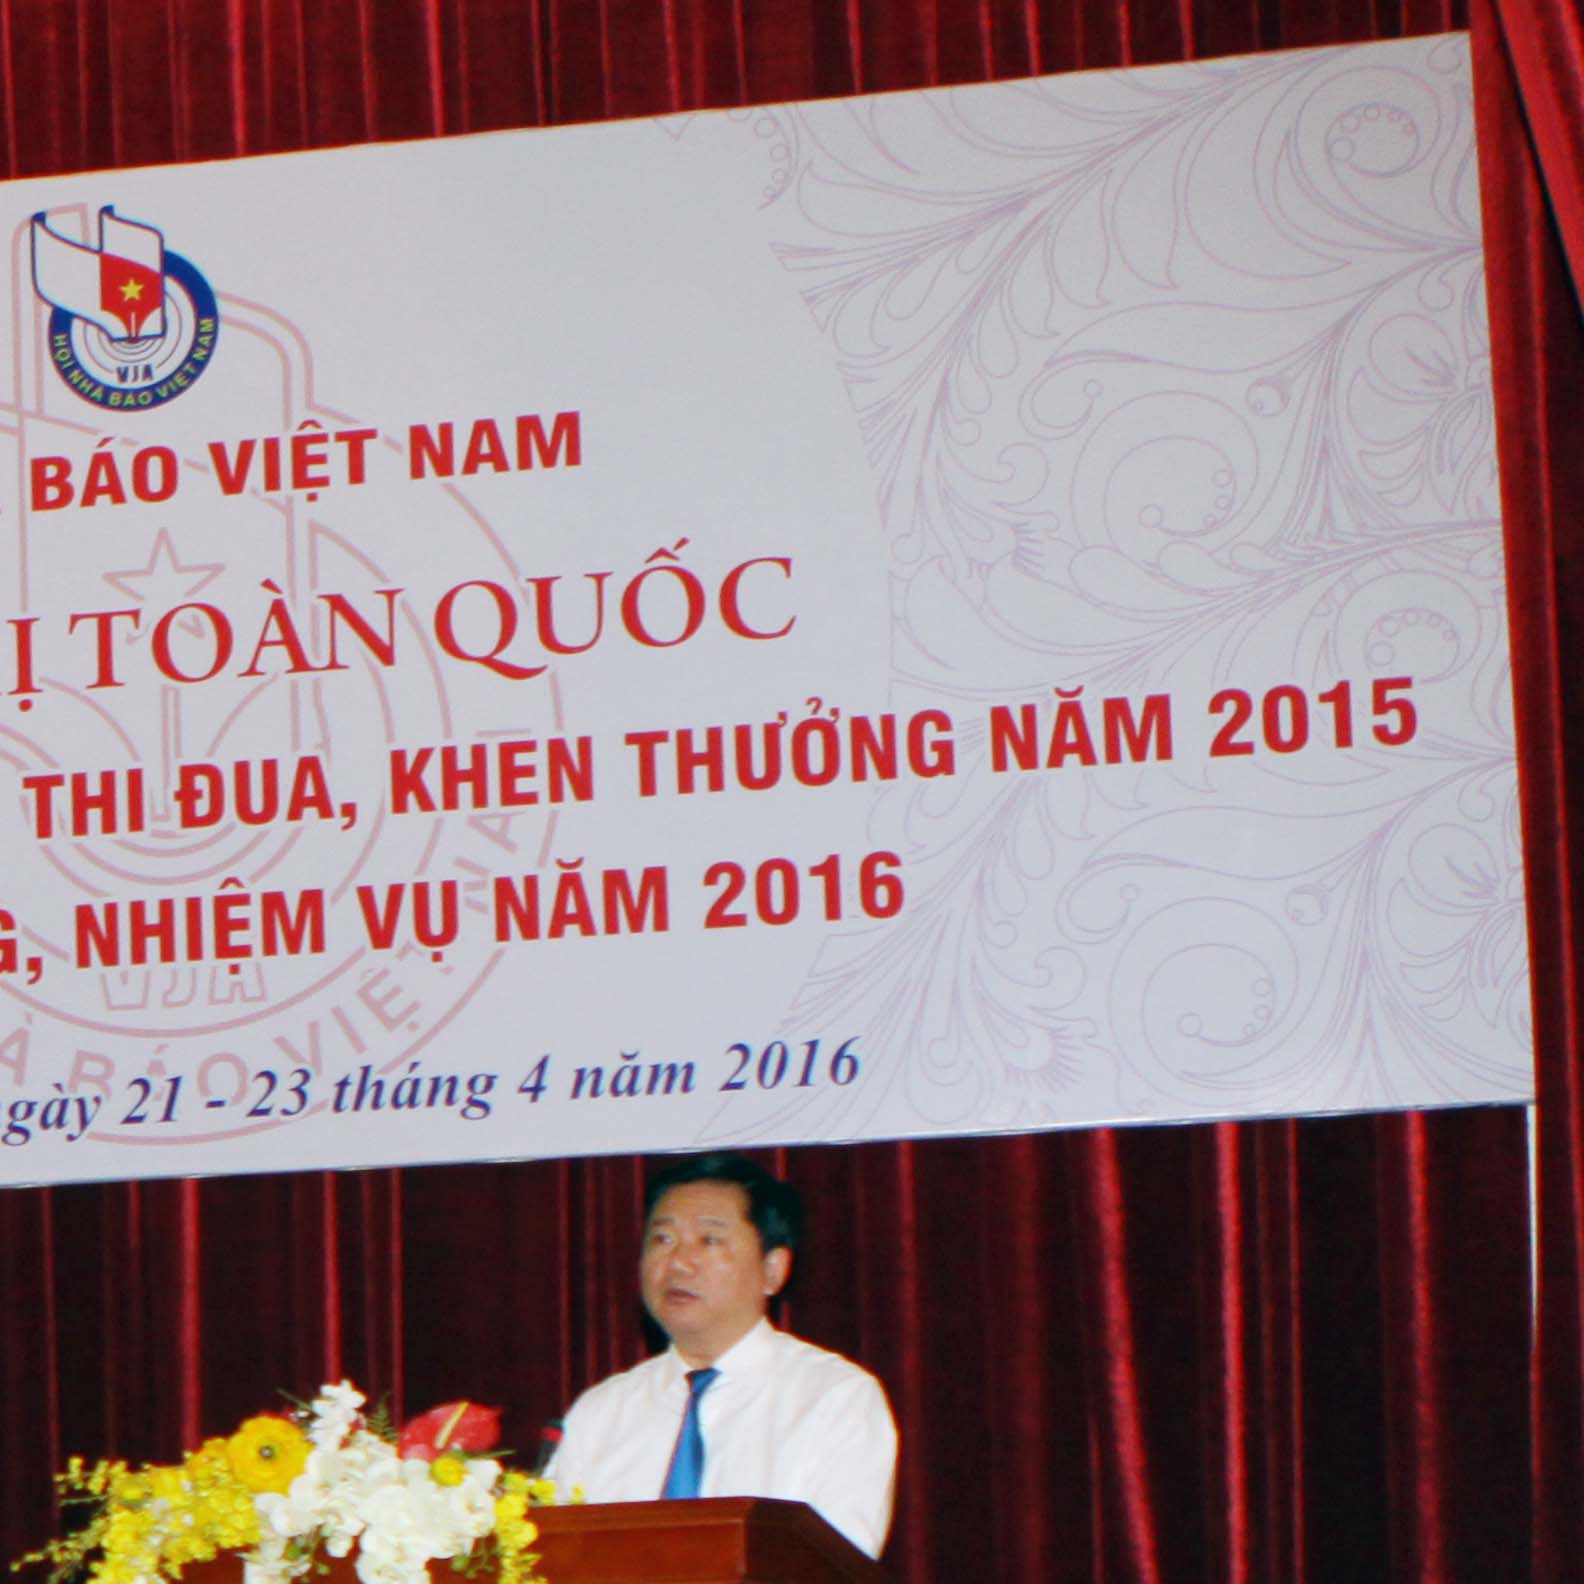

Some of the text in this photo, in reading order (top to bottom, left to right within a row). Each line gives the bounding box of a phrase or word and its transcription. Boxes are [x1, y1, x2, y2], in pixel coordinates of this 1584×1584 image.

[115, 364, 154, 383] VJA
[192, 317, 215, 362] NAM
[32, 438, 178, 511] BÁO
[209, 420, 377, 502] VIỆT
[410, 412, 581, 479] NAM
[70, 580, 401, 688] TOÀN
[435, 538, 792, 680] QUỐC
[23, 768, 144, 838] THI
[174, 756, 357, 830] ĐUA,
[391, 736, 593, 814] KHEN
[625, 697, 955, 796] THƯỞNG
[991, 688, 1172, 772] NĂM
[1208, 677, 1417, 757] 2015
[76, 877, 325, 974] NHIỆM
[357, 880, 458, 962] VỤ
[495, 859, 668, 942] NĂM
[704, 851, 904, 928] 2016
[123, 1077, 181, 1123] 21
[248, 1069, 310, 1116] 23
[334, 1062, 496, 1116] tháng
[520, 1056, 548, 1101] 4
[572, 1054, 693, 1098] năm
[721, 1039, 857, 1090] 2016
